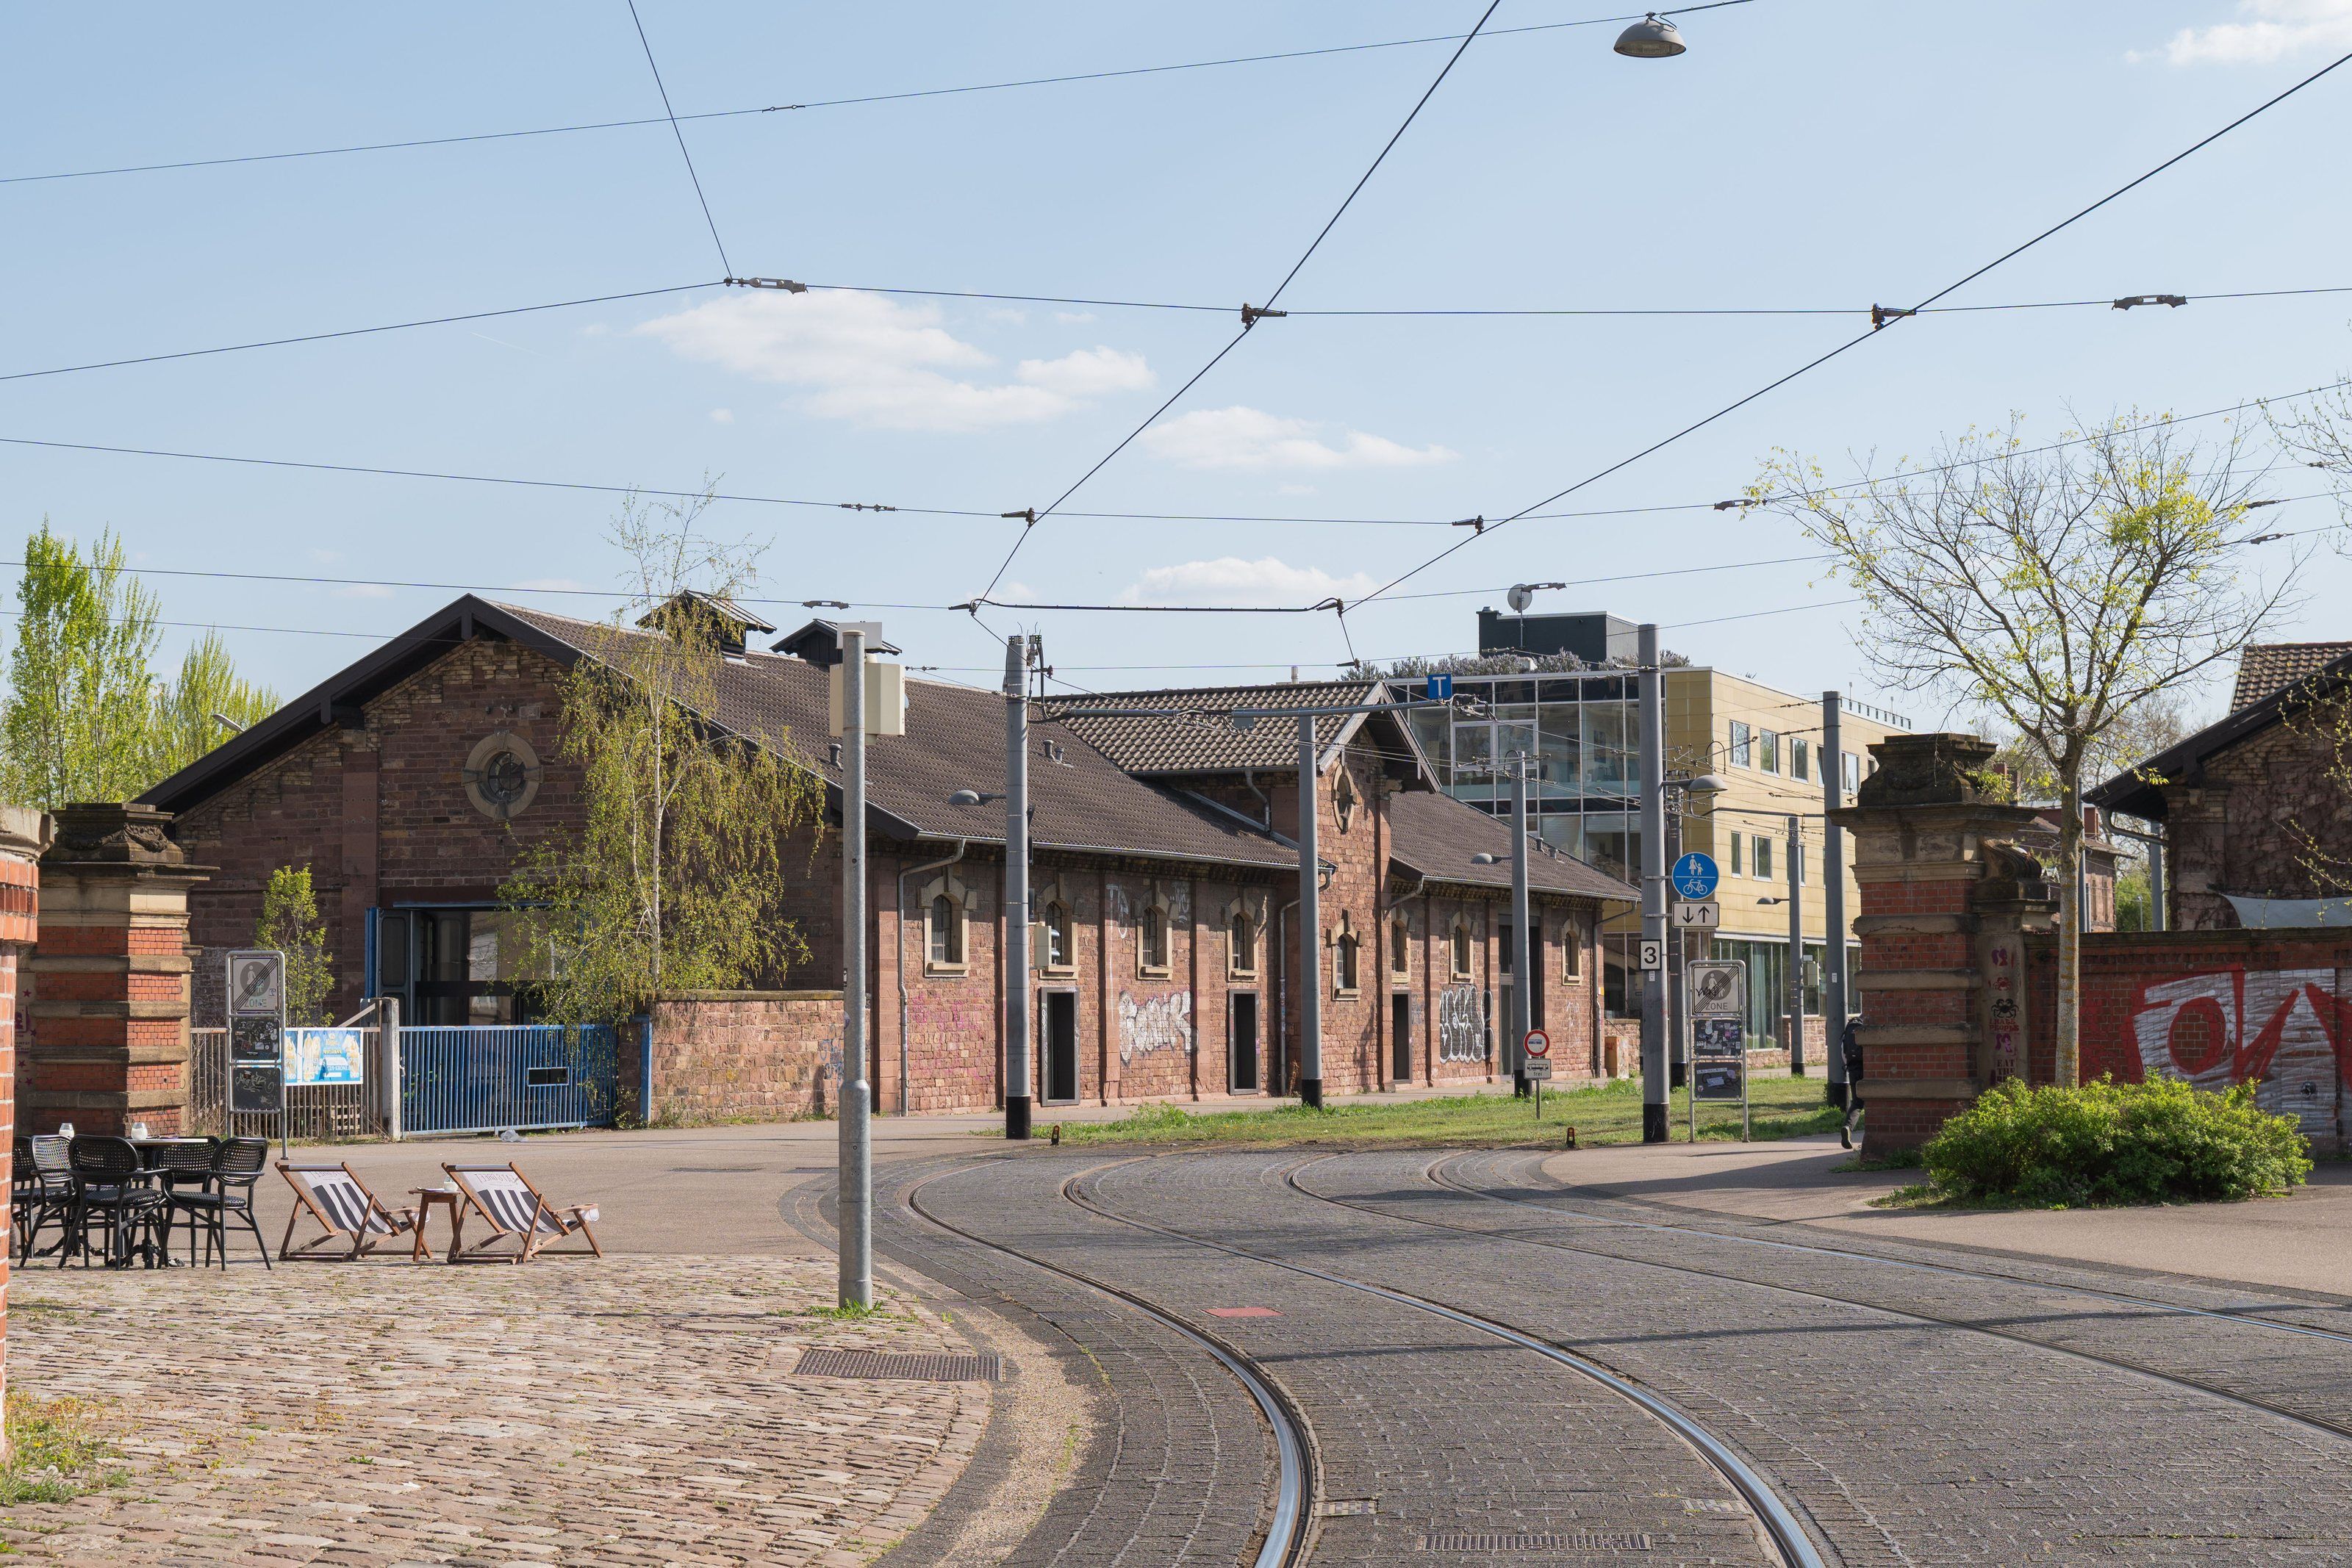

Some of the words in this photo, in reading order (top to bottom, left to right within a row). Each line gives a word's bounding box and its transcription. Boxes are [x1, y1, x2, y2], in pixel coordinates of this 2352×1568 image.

[1433, 676, 1446, 697] T
[1644, 946, 1657, 964] 3
[1705, 1002, 1729, 1010] ZONE
